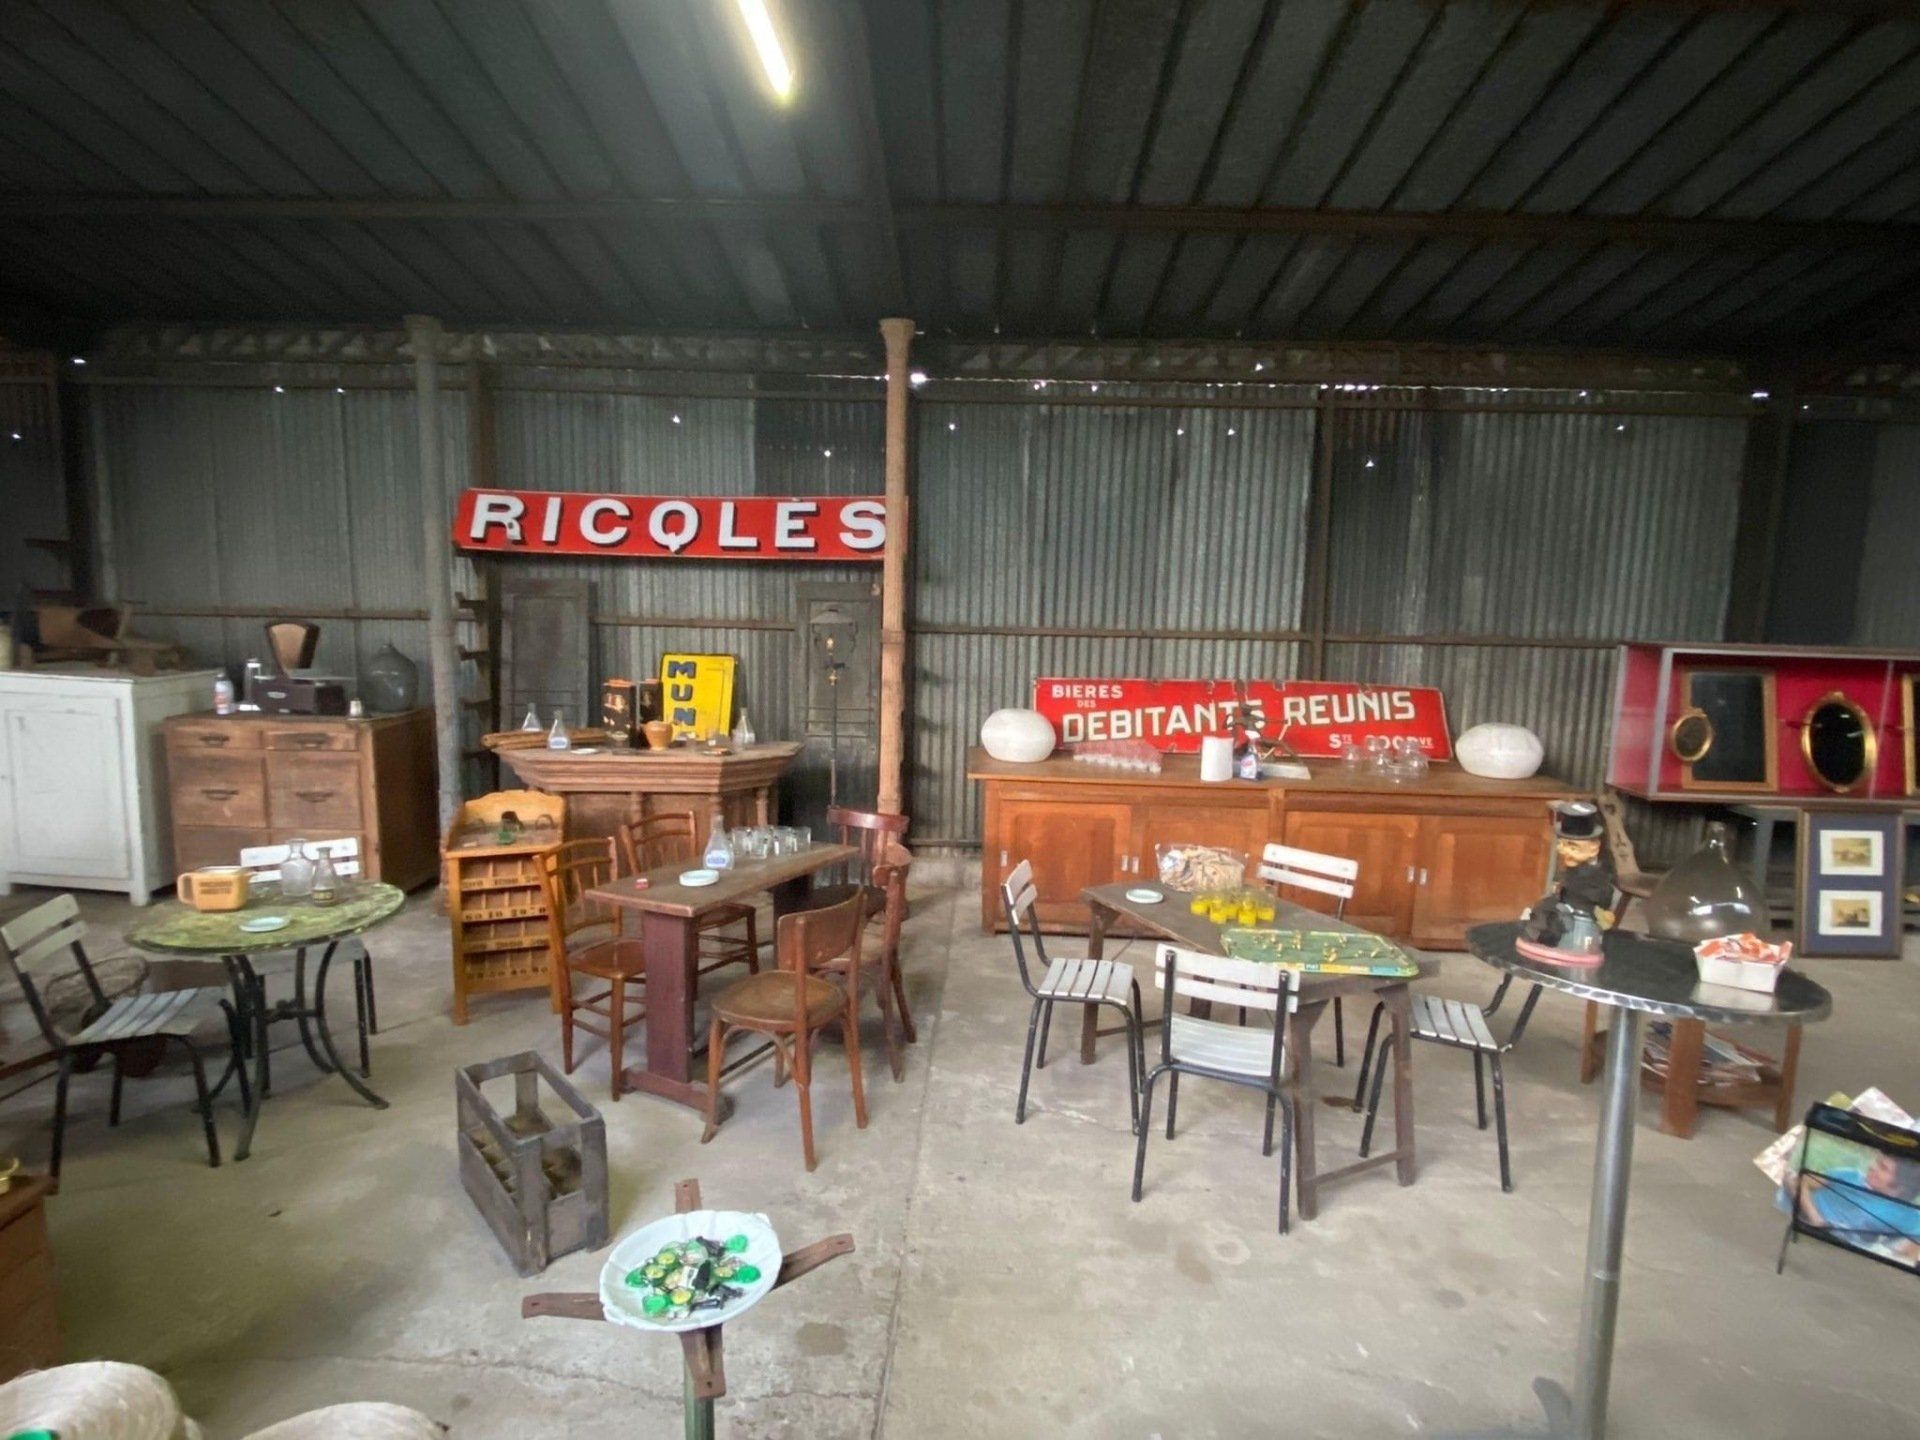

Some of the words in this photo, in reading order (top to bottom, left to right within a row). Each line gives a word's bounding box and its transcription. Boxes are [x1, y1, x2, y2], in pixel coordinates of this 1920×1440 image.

[1051, 684, 1124, 699] BIERES
[1077, 700, 1097, 708] DES
[1283, 690, 1416, 726] REUNIS
